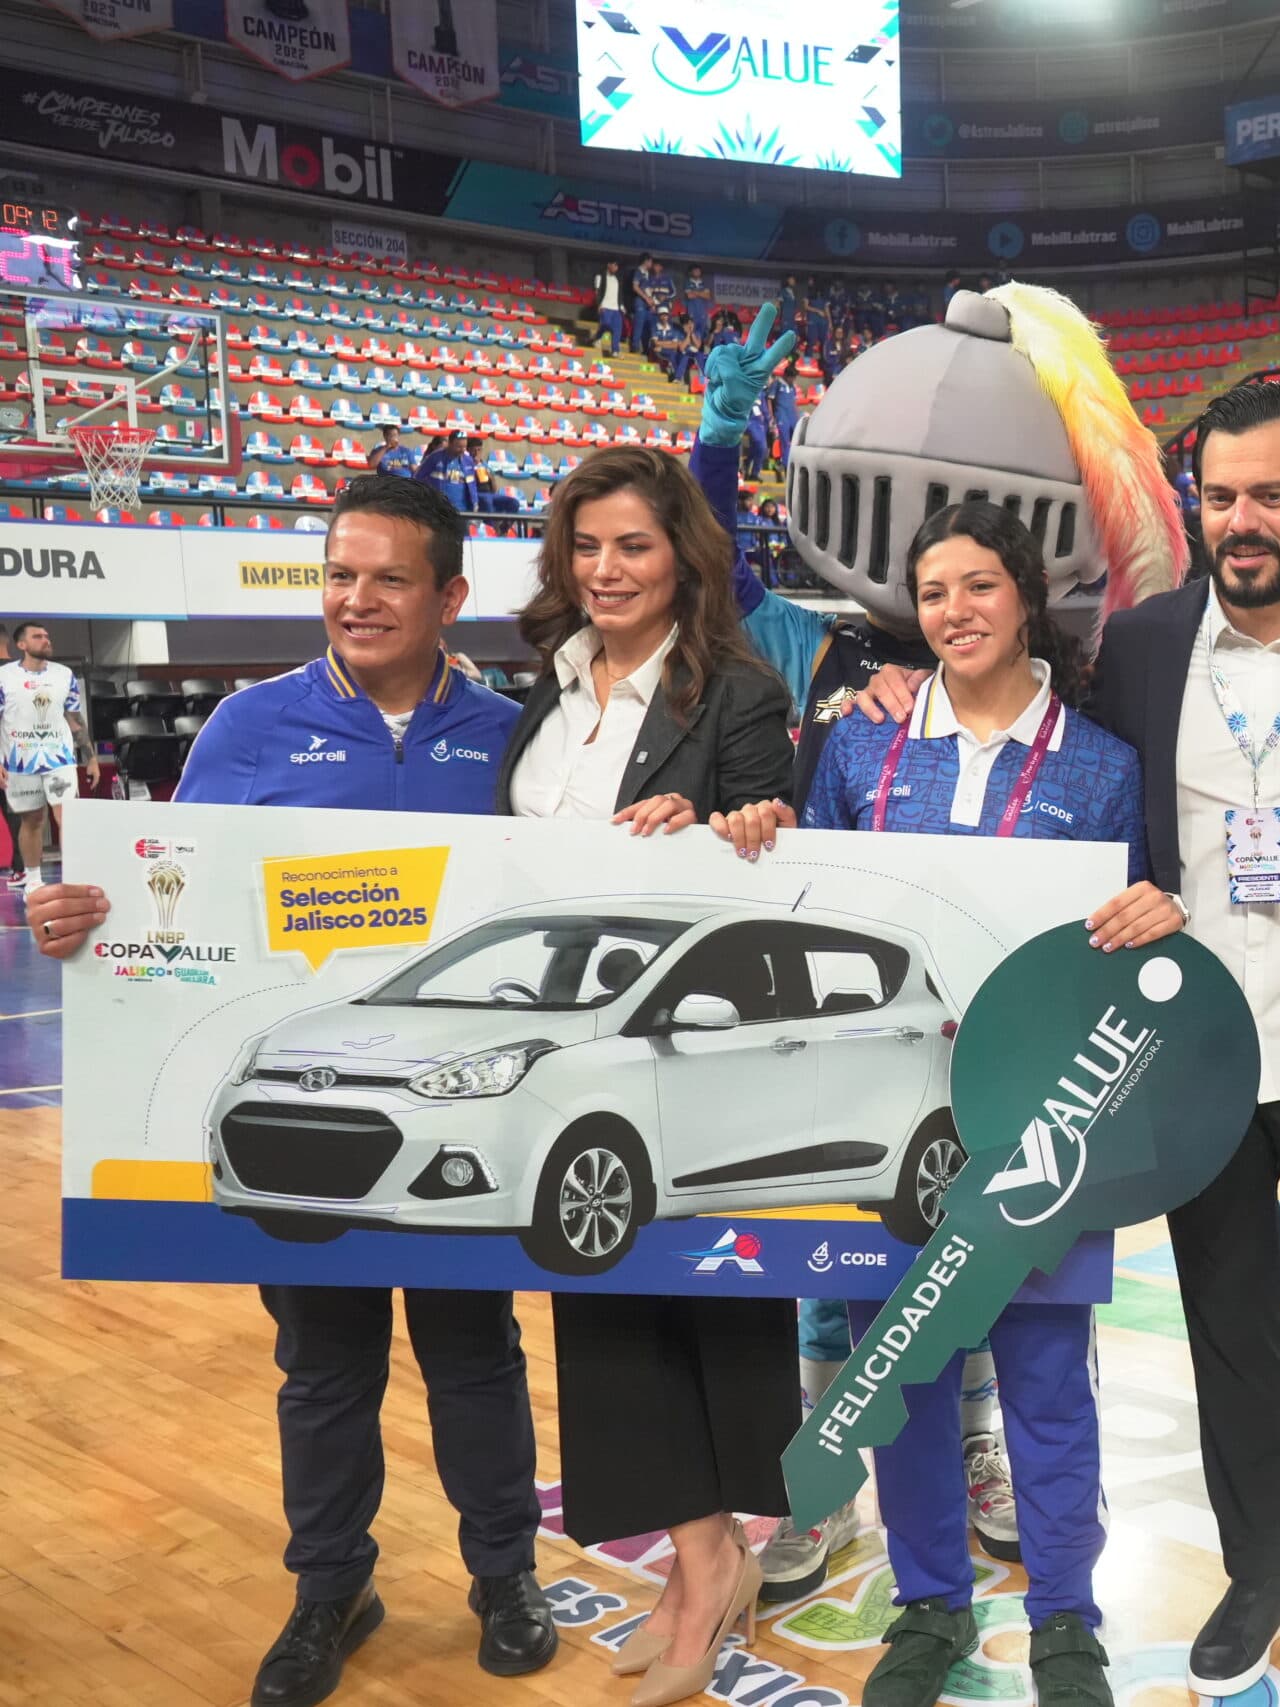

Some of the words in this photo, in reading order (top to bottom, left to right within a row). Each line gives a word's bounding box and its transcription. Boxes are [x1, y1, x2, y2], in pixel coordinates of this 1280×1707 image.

[243, 16, 336, 52] CAMPEÓN
[407, 50, 485, 85] CAMPEÓN
[657, 25, 834, 90] VALUE
[221, 116, 393, 201] Mobil
[543, 191, 693, 237] ASTROS
[334, 227, 383, 249] SECCIÓN
[0, 547, 105, 579] DURA
[242, 565, 320, 586] IMPER
[290, 750, 346, 764] sporelli
[456, 748, 489, 762] CODE
[866, 785, 911, 801] sprelli
[1039, 801, 1074, 824] CODE
[282, 867, 388, 883] Reconocimiento
[390, 867, 398, 876] a
[280, 882, 399, 907] Selección
[283, 910, 365, 933] Jalisco
[368, 907, 428, 928] 2025
[147, 931, 185, 944] LNBP
[114, 965, 165, 977] JALISCO
[1107, 1037, 1165, 1116] ARRENDADORA
[983, 1005, 1149, 1195] VALUE
[840, 1252, 887, 1266] CODE
[817, 1234, 975, 1456] ¡FELICIDADES!
